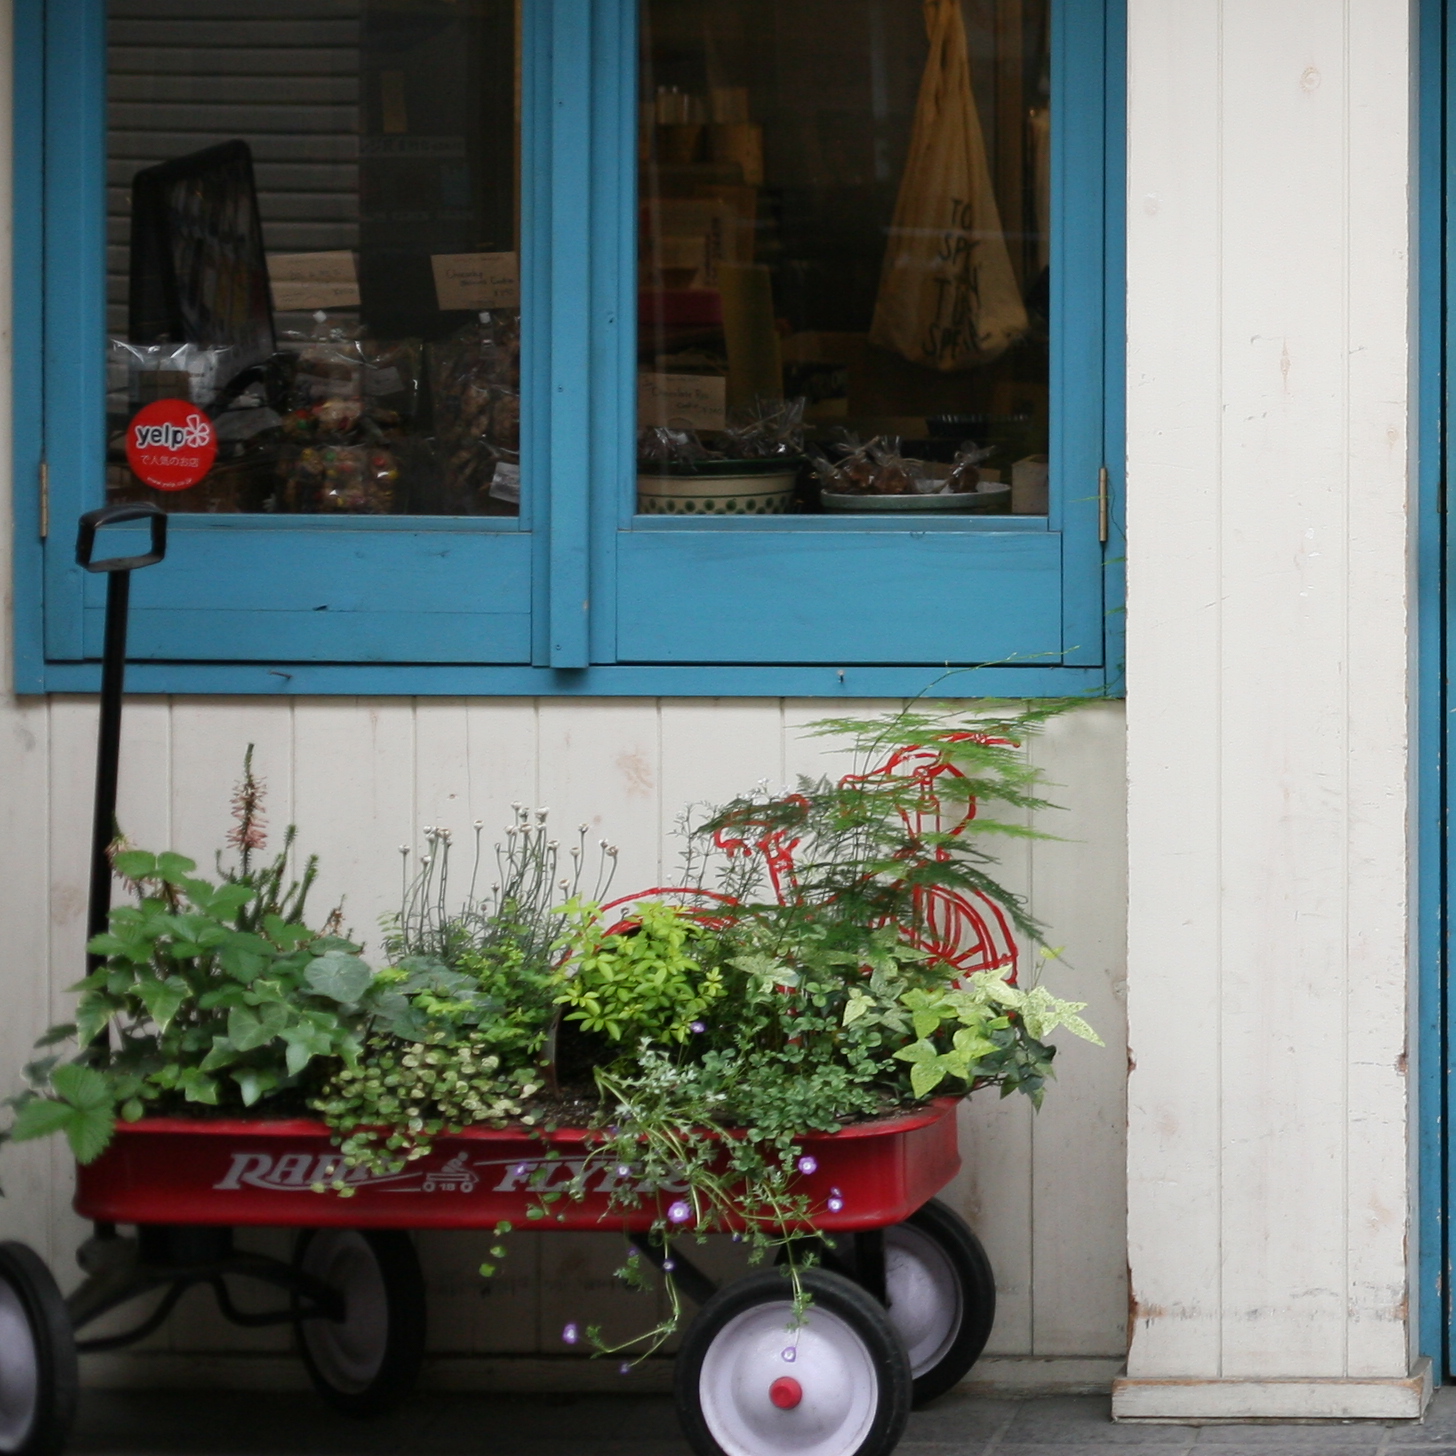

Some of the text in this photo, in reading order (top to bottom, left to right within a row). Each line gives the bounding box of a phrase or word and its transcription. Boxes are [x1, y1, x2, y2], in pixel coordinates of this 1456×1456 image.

[135, 421, 186, 451] yelp
[140, 454, 200, 468] で人気のお店
